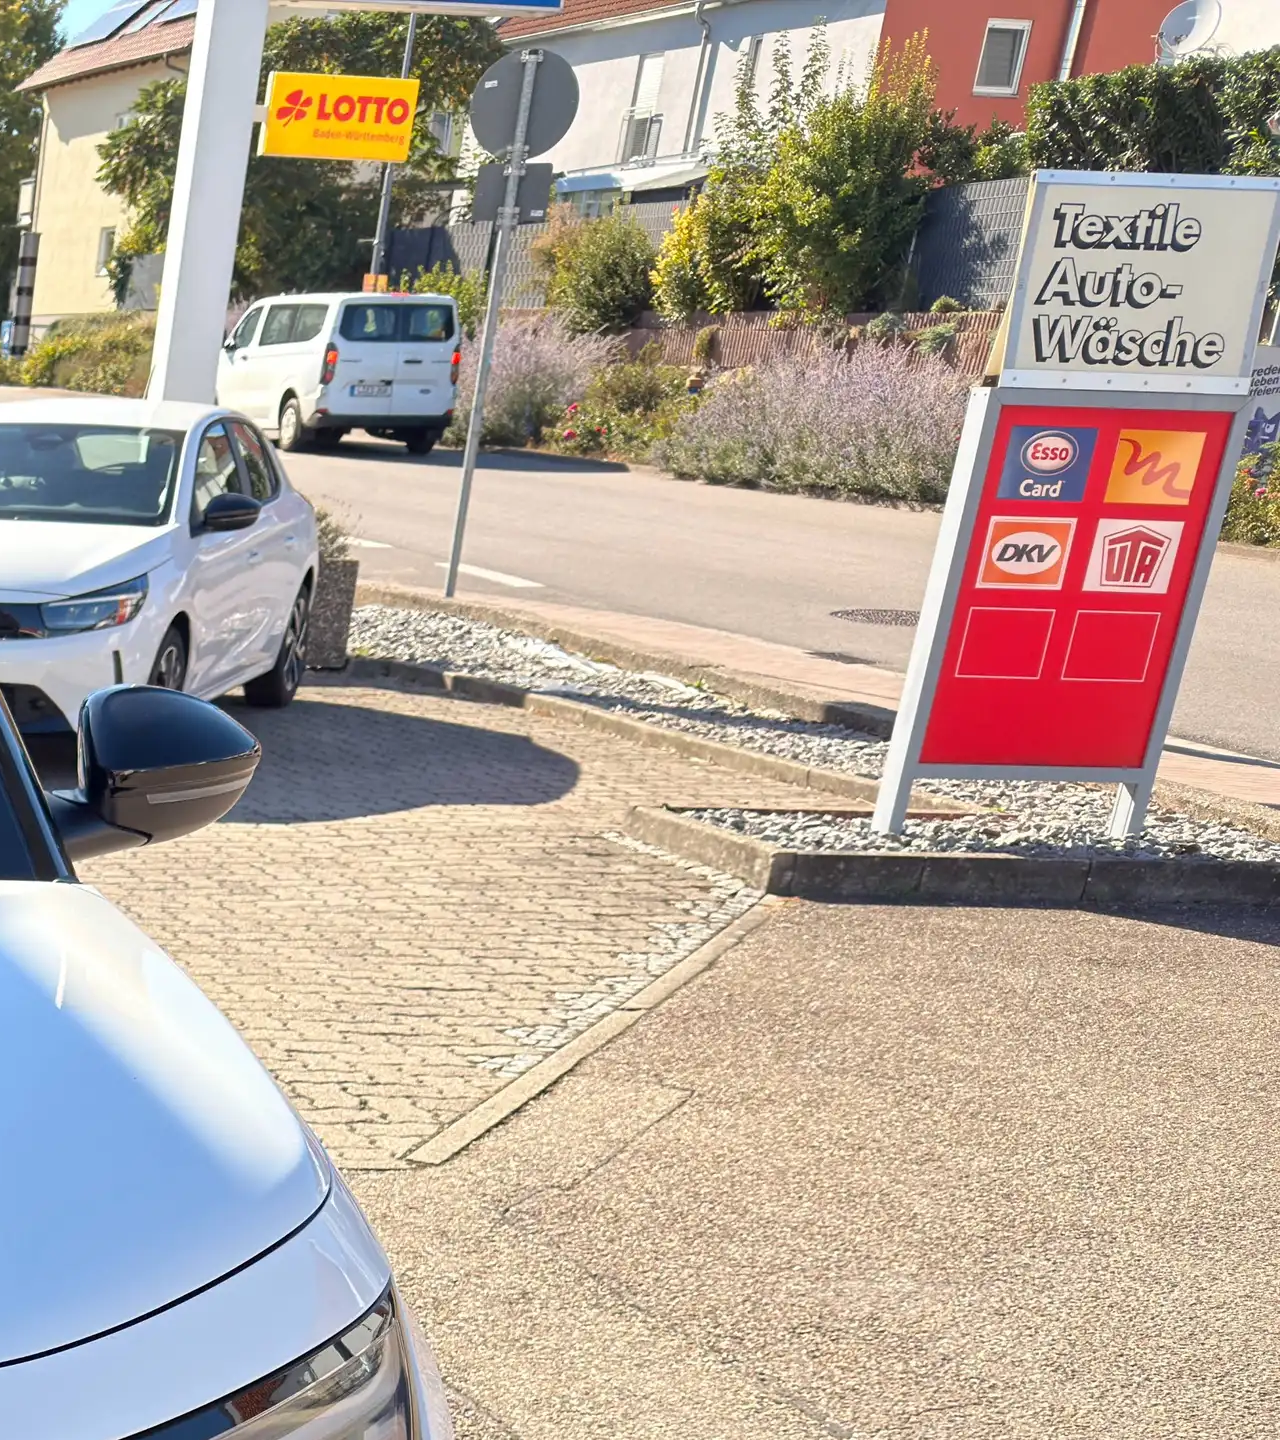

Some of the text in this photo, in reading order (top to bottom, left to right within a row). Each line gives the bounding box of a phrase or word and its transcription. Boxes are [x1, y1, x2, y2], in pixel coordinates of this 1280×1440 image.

[316, 93, 410, 125] LOTTO
[312, 128, 405, 146] Baden-Württemberg
[1053, 202, 1202, 252] Textile
[1034, 256, 1184, 309] Auto-
[1032, 313, 1225, 369] Wäsche
[1251, 364, 1280, 377] rede
[1030, 442, 1070, 462] Esso
[1019, 478, 1064, 498] Card
[996, 543, 1058, 563] DKV
[1105, 529, 1166, 584] UTA
